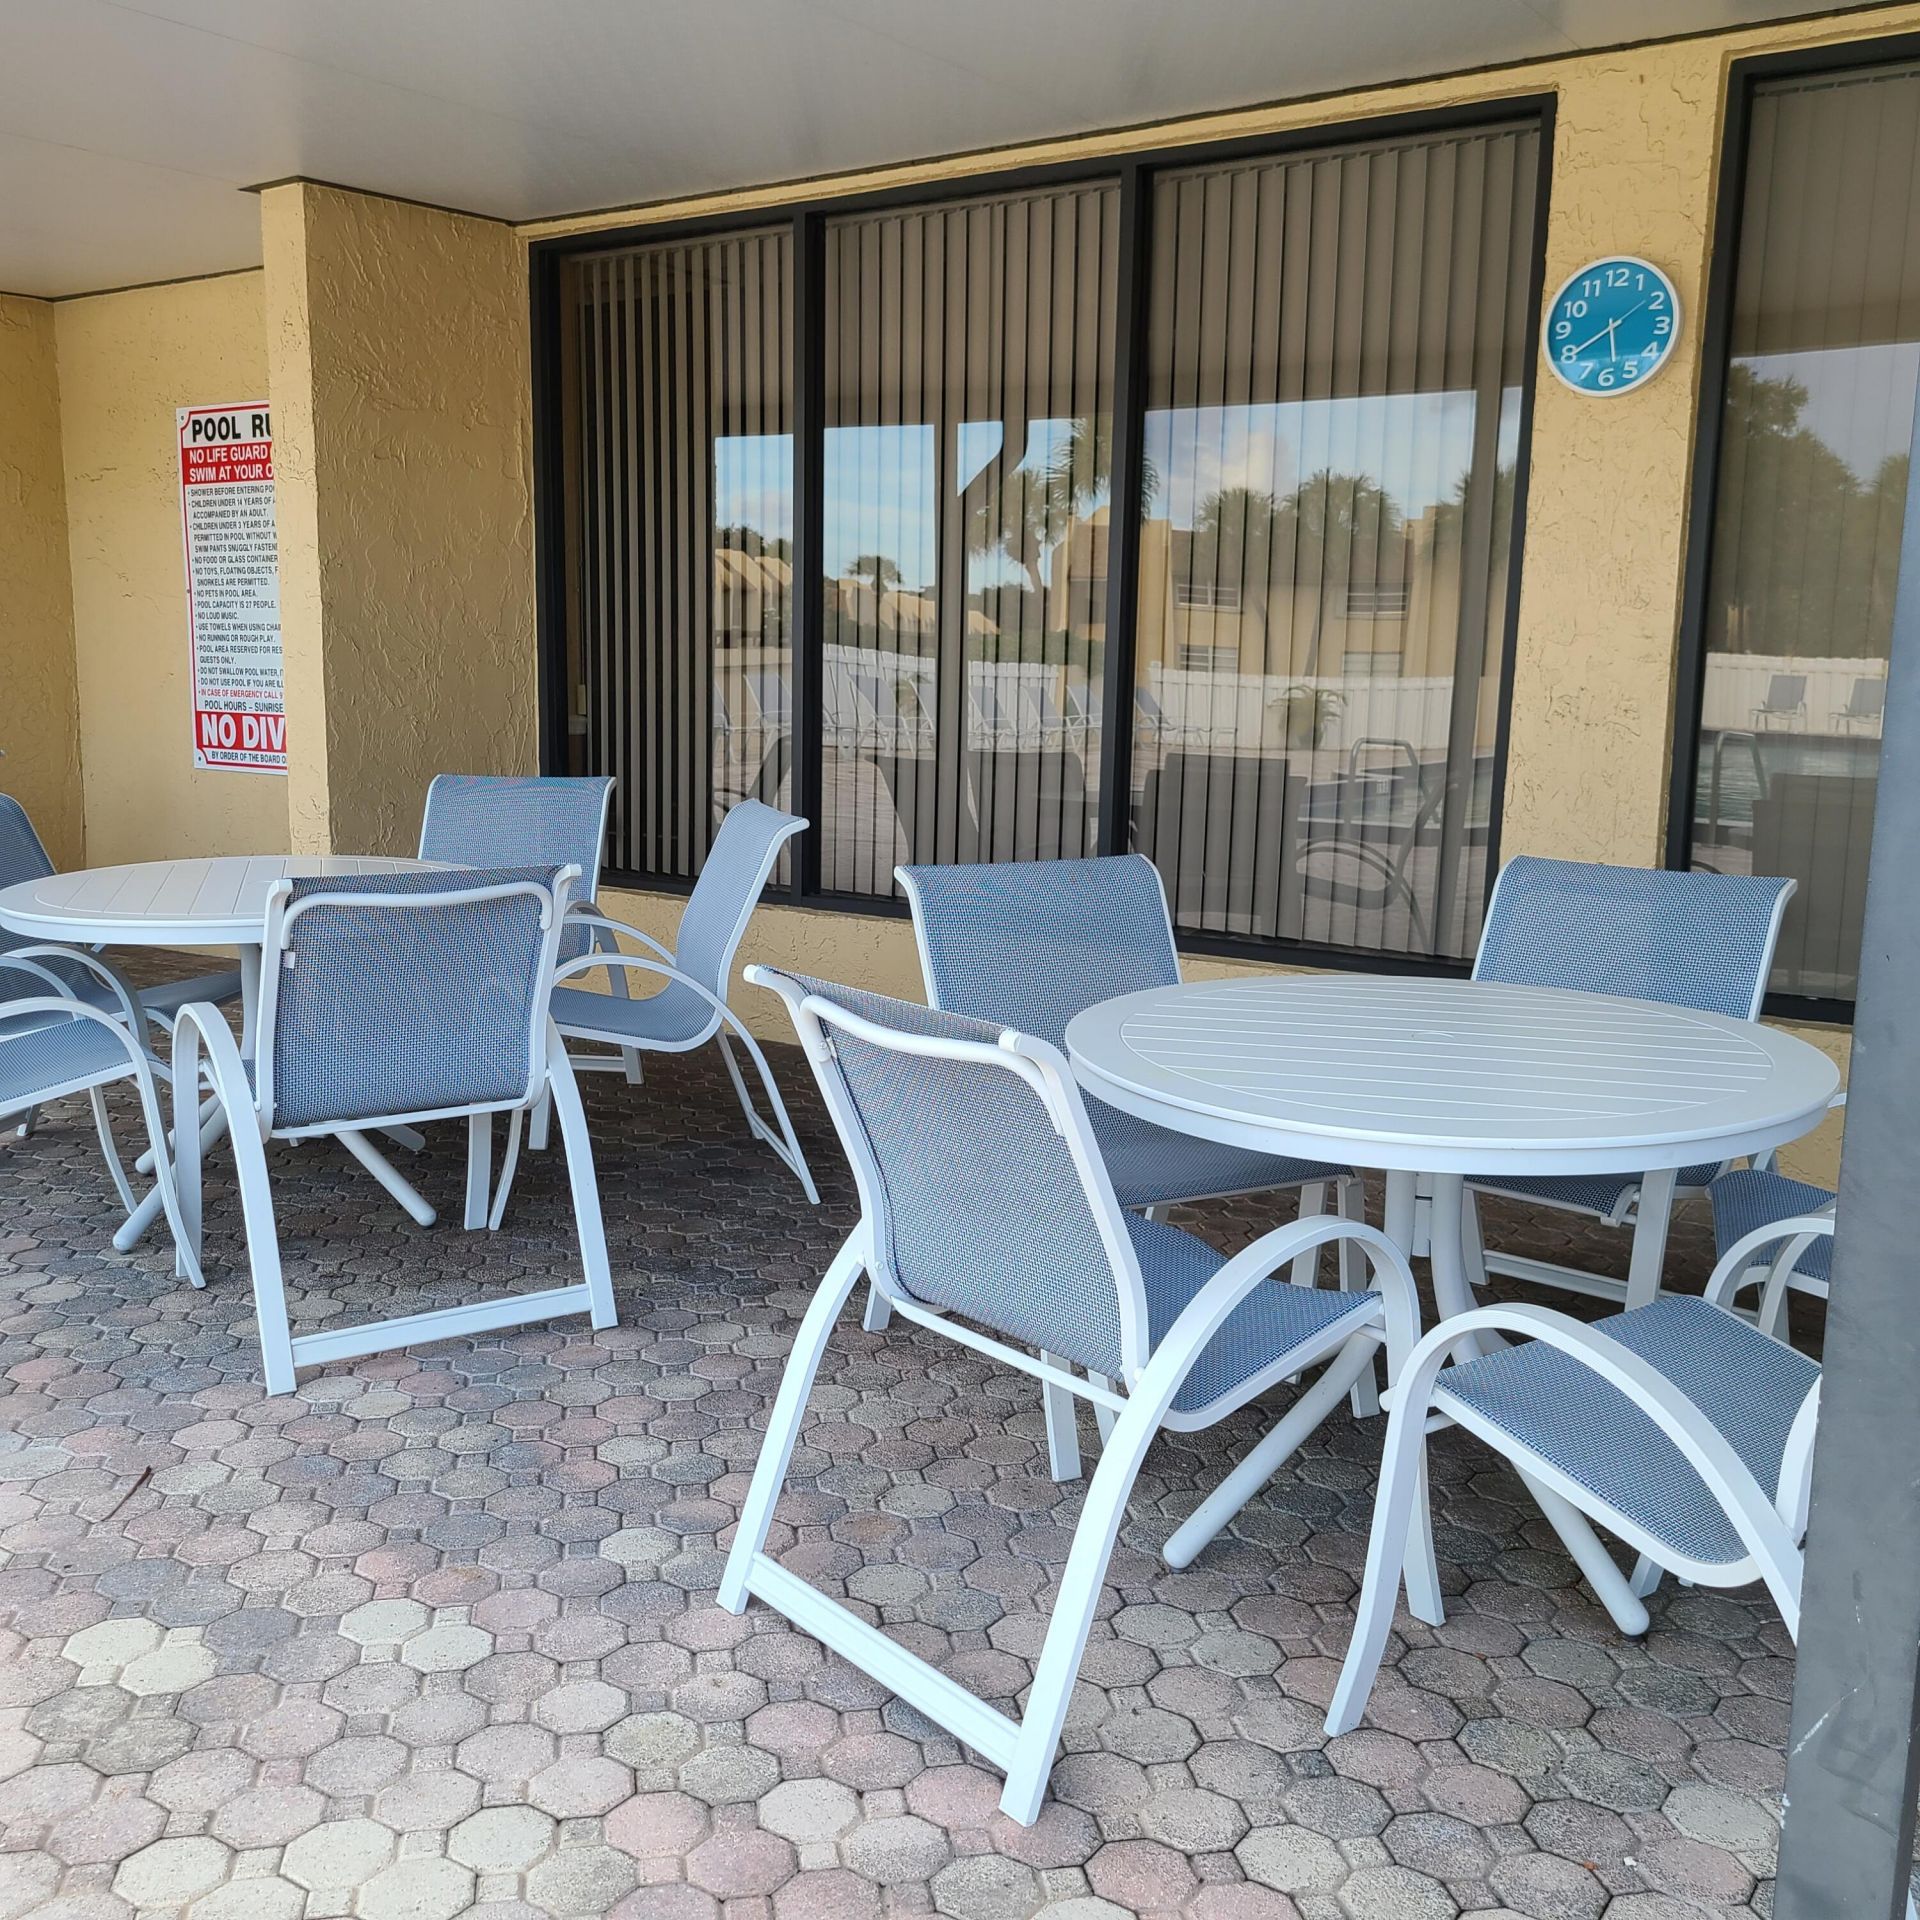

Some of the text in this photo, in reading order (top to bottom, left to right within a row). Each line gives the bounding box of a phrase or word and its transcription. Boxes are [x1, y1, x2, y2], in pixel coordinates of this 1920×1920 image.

[1606, 268, 1629, 287] 12
[1636, 274, 1644, 291] 1
[1582, 280, 1600, 297] 11
[1564, 300, 1588, 318] 10
[1648, 291, 1665, 310] 2
[1555, 321, 1571, 340] 9
[1653, 316, 1670, 335] 3
[1561, 344, 1577, 364] 8
[1641, 341, 1660, 360] 4
[1579, 362, 1594, 380] 7
[1598, 368, 1615, 386] 6
[1622, 360, 1638, 379] 5
[192, 416, 241, 442] POOL
[190, 445, 268, 464] NO LIFE GUARD
[190, 467, 216, 482] SWIM
[219, 466, 231, 480] AT
[233, 464, 263, 479] YOUR
[191, 488, 213, 496] SHOWER
[214, 487, 235, 495] BEFORE
[237, 486, 264, 494] ENTERING
[193, 510, 230, 519] ACCOMPANIED
[246, 532, 271, 540] WITHOUT
[195, 545, 208, 553] SWIM
[210, 544, 227, 552] PANTS
[228, 543, 253, 552] SNUGGLY
[228, 555, 246, 563] GLASS
[220, 566, 246, 575] FLOATING
[210, 623, 231, 631] TOWELS
[232, 623, 248, 631] WHEN
[249, 623, 265, 632] USING
[230, 645, 258, 654] RESERVED
[219, 667, 244, 675] SWALLOW
[220, 678, 230, 686] USE
[205, 700, 222, 709] POOL
[224, 701, 246, 711] HOURS
[254, 702, 283, 712] SUNRISE
[202, 714, 285, 750] NO DIV
[220, 752, 238, 760] ORDER
[240, 753, 247, 761] OF
[248, 754, 259, 762] THE
[260, 754, 280, 763] BOARD
